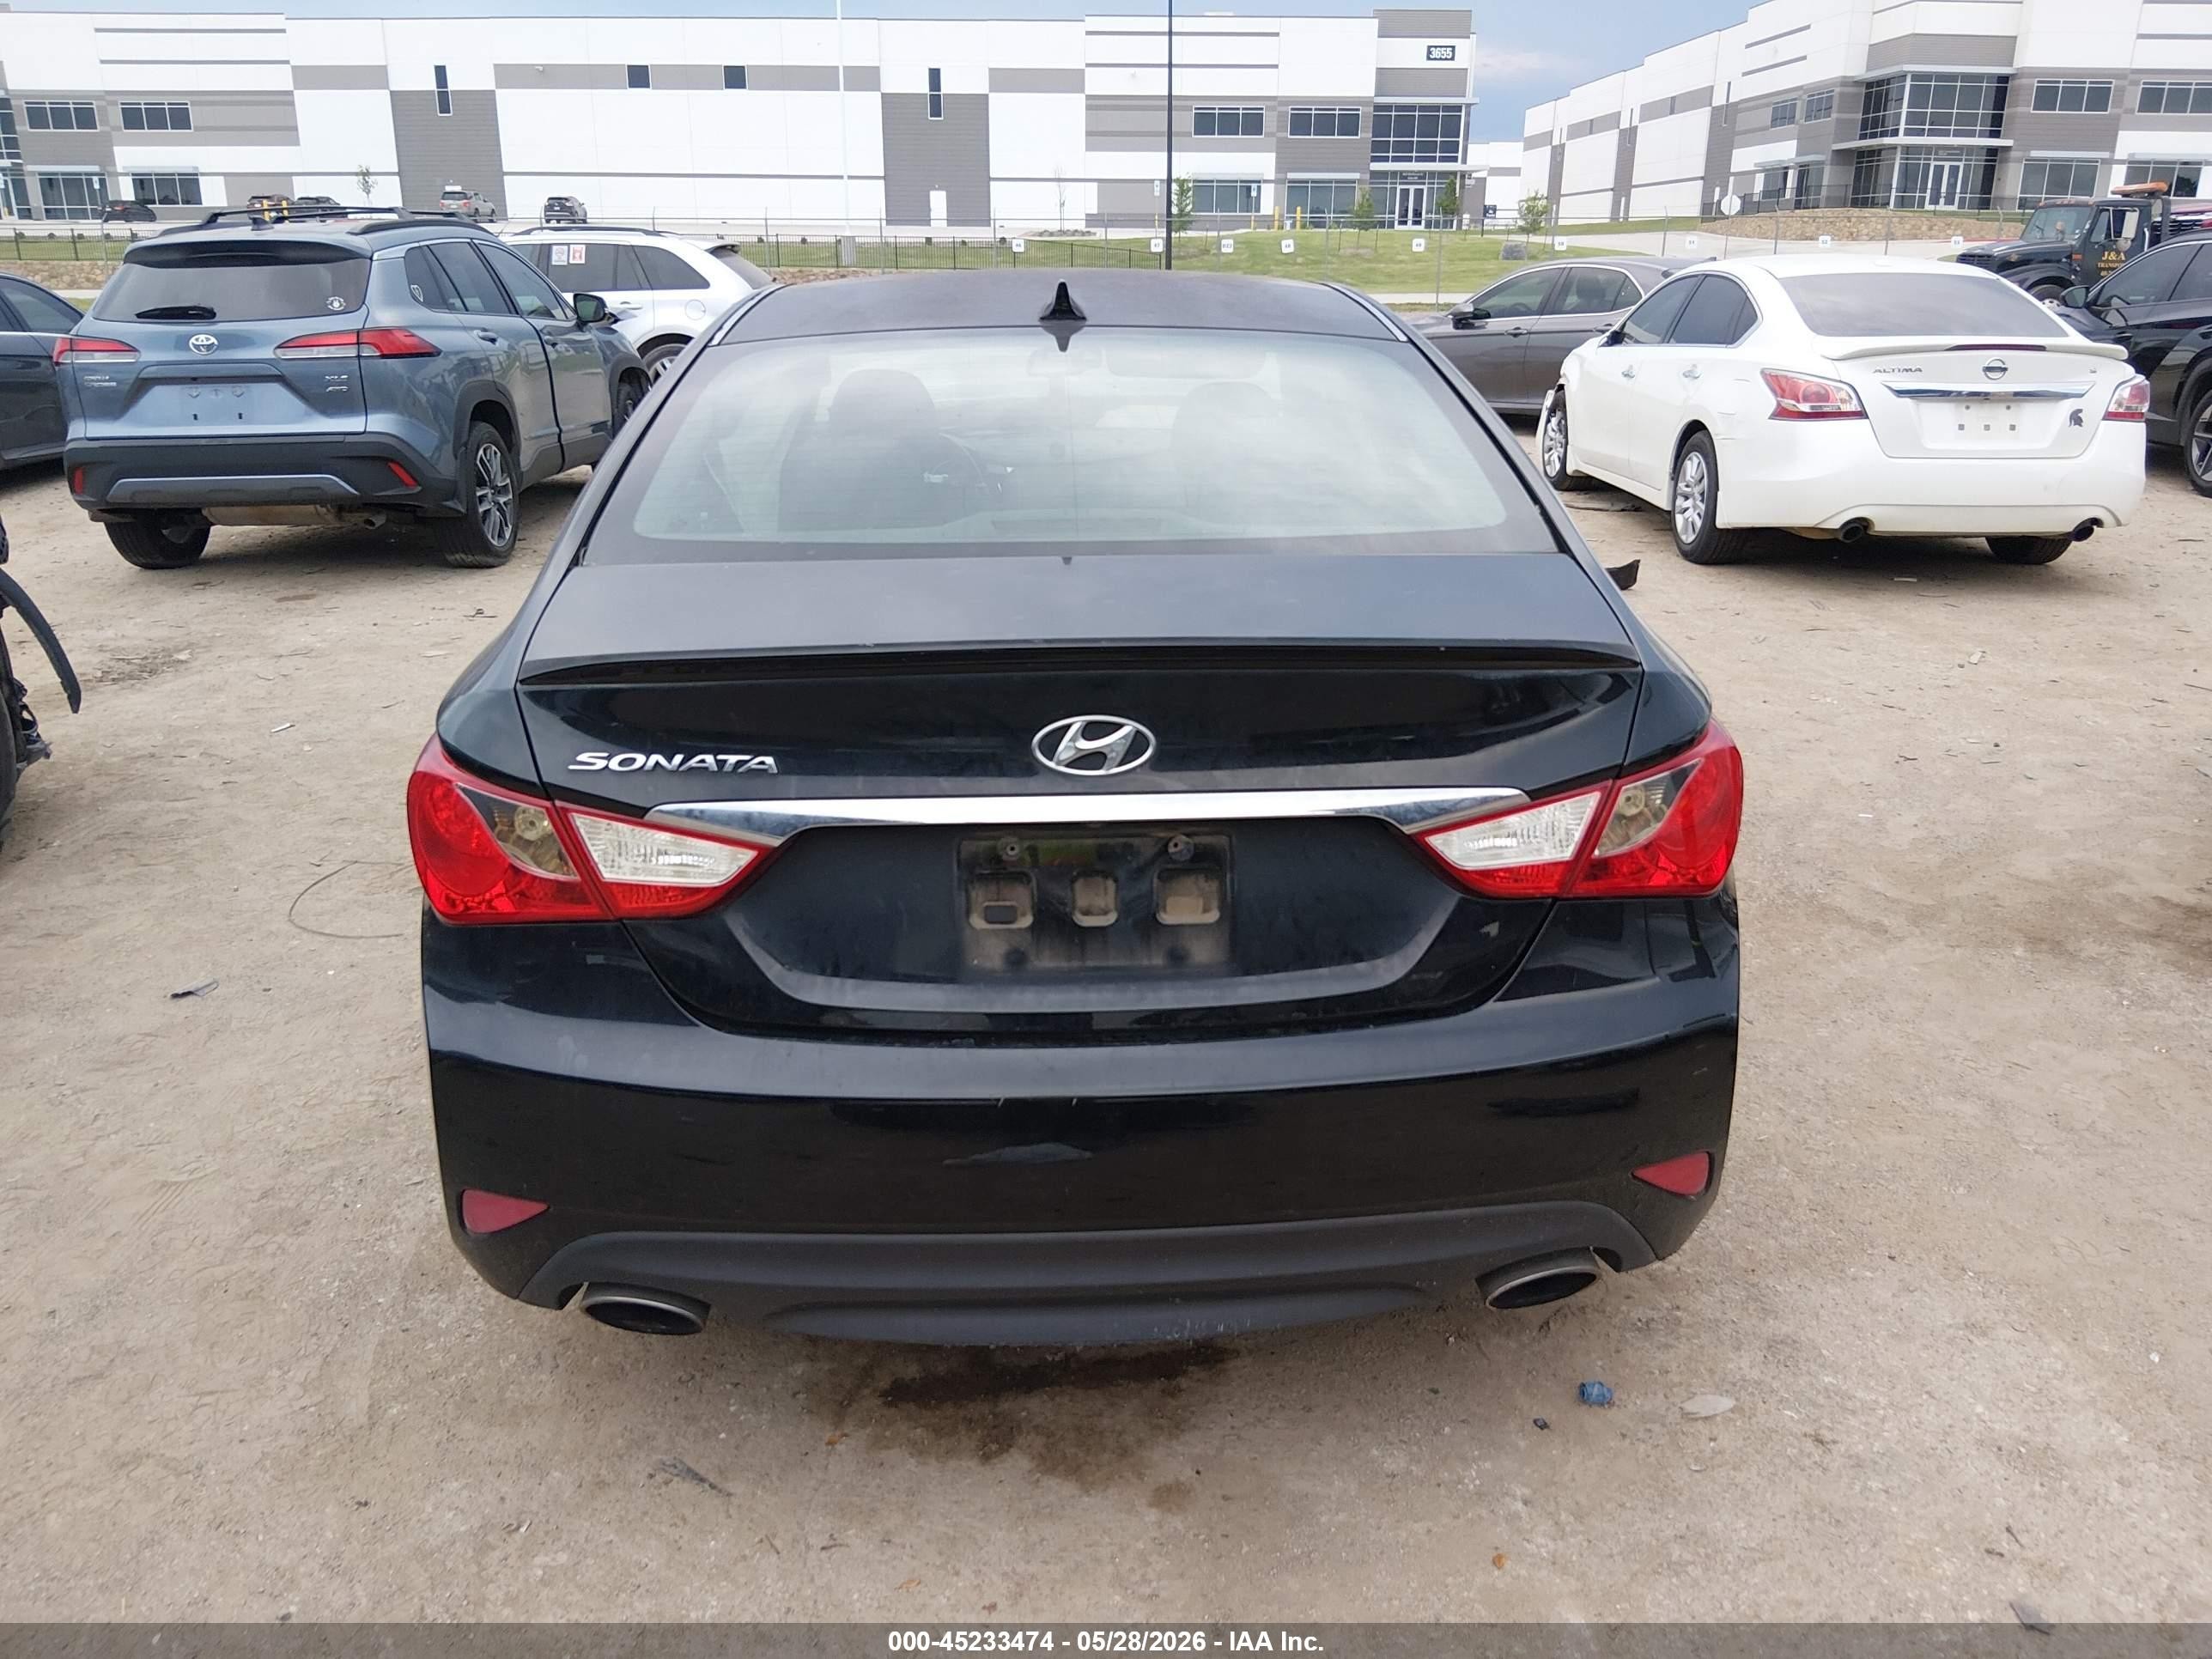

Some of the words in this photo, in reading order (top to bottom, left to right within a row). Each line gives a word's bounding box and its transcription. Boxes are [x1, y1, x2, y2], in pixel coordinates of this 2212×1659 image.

[1429, 47, 1453, 59] 3655
[2101, 251, 2126, 260] J&A
[568, 752, 778, 774] SONATA
